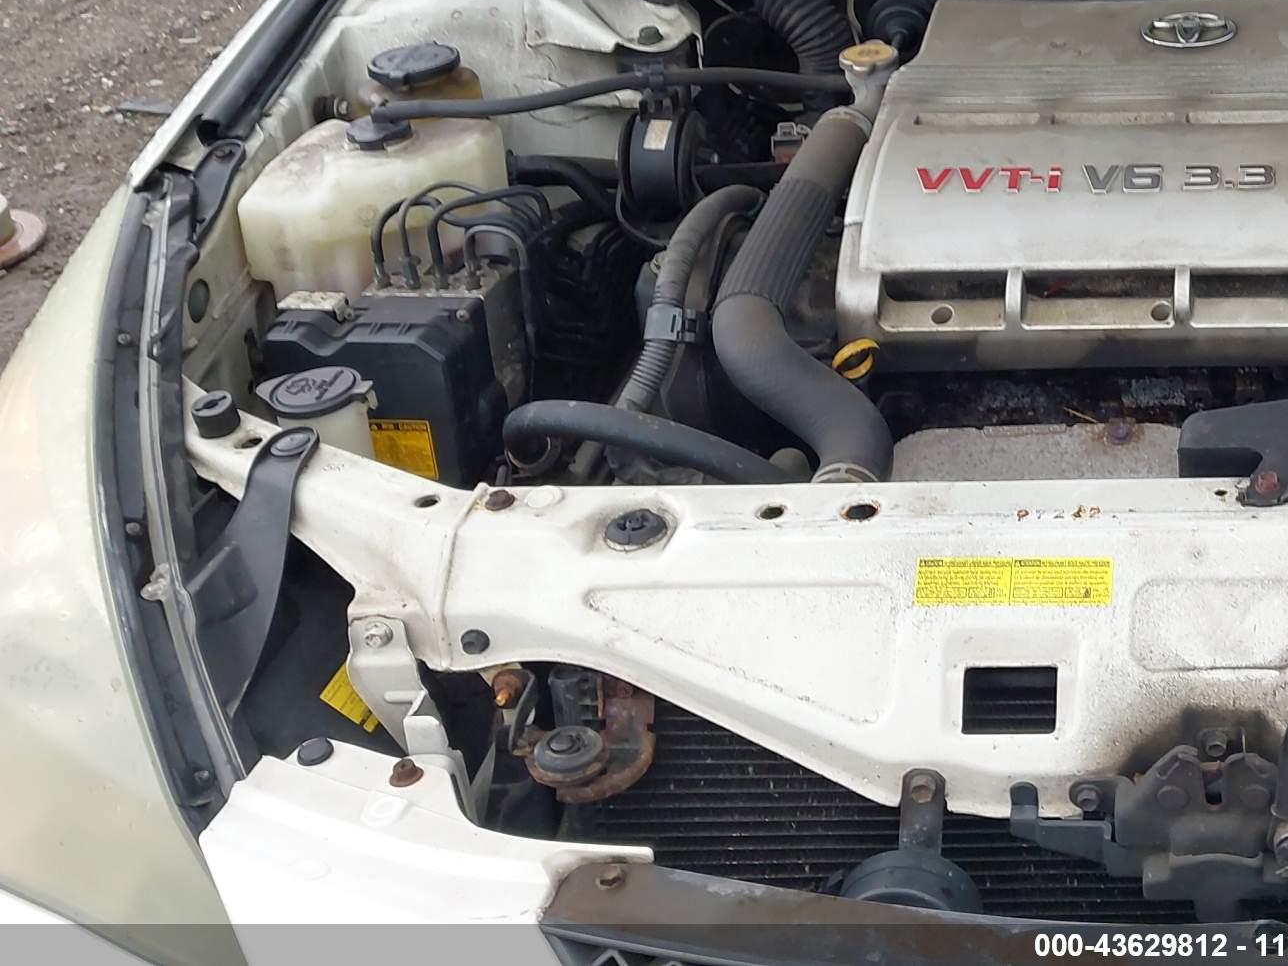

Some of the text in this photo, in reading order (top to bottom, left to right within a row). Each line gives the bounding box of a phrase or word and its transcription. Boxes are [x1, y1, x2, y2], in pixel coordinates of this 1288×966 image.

[914, 164, 1276, 194] VVT-i V6 3.3
